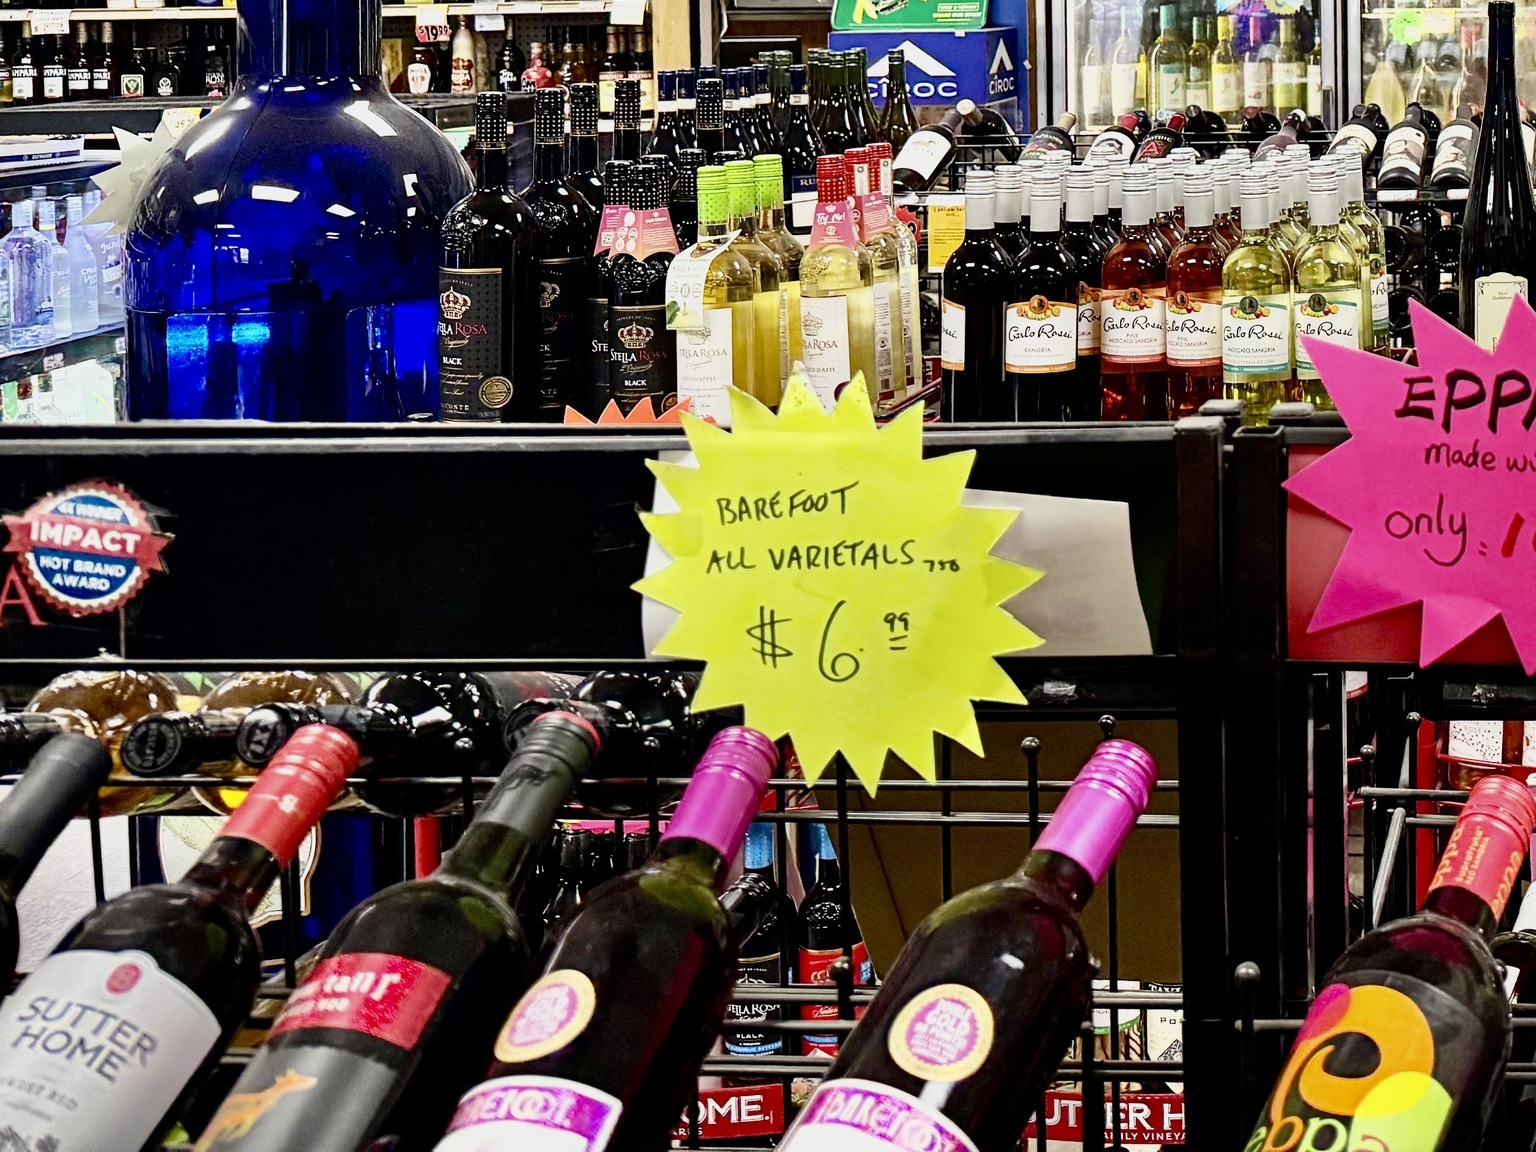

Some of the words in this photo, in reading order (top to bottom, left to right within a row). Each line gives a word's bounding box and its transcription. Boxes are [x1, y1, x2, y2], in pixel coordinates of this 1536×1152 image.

[455, 321, 488, 335] ROSA
[1103, 317, 1130, 332] Carlo
[1181, 318, 1217, 335] Rossi
[1223, 326, 1247, 341] Carlo
[1249, 324, 1284, 340] Rossi
[1316, 322, 1353, 337] Rossi
[1009, 326, 1036, 342] Carlo
[813, 338, 839, 350] ROSA
[442, 356, 463, 366] BLACK
[610, 349, 637, 362] STELLA
[639, 350, 668, 361] ROSA
[700, 348, 728, 359] ROSA
[624, 379, 647, 387] BLACK
[717, 480, 860, 526] BAREFOOT
[76, 504, 123, 522] WINNER
[30, 520, 141, 554] IMPACT
[706, 546, 757, 575] ALL
[769, 539, 916, 571] VARIETALS
[40, 555, 71, 570] HOT
[73, 559, 127, 578] BRAND
[52, 574, 111, 592] AWARD
[18, 995, 160, 1067] SUTTER
[11, 1023, 133, 1084] HOME
